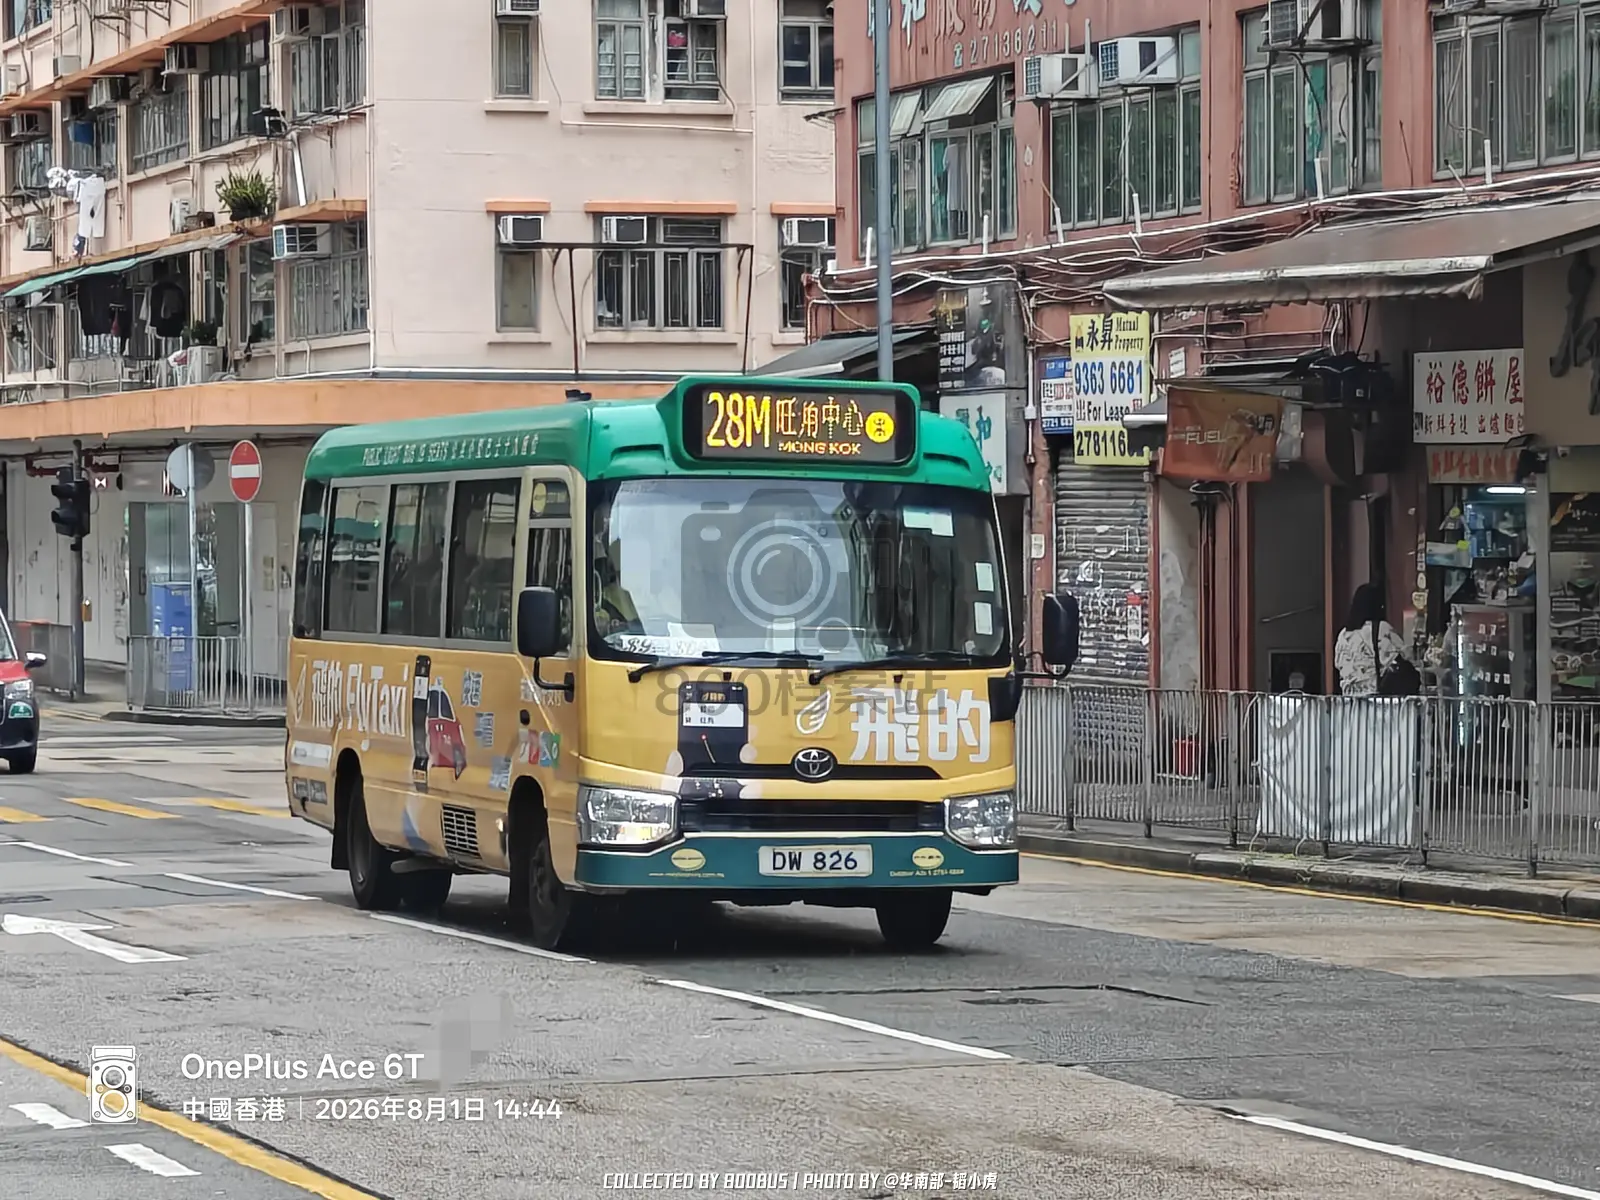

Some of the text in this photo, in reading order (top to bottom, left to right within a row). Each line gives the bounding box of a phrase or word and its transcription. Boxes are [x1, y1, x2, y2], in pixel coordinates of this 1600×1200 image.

[969, 19, 1058, 66] 27136211
[1086, 319, 1113, 351] 永昇
[1116, 317, 1139, 332] Mutual
[1115, 334, 1144, 352] Property
[1074, 361, 1104, 396] 9363
[1110, 360, 1143, 394] 6681
[706, 391, 771, 448] 28M
[776, 396, 864, 439] 旺角中心
[1087, 401, 1101, 421] For
[778, 441, 862, 455] MONG KOK
[1076, 430, 1144, 458] 278116
[346, 663, 409, 752] FlyTaxi
[849, 687, 991, 763] 飛的
[772, 850, 858, 871] DW 826
